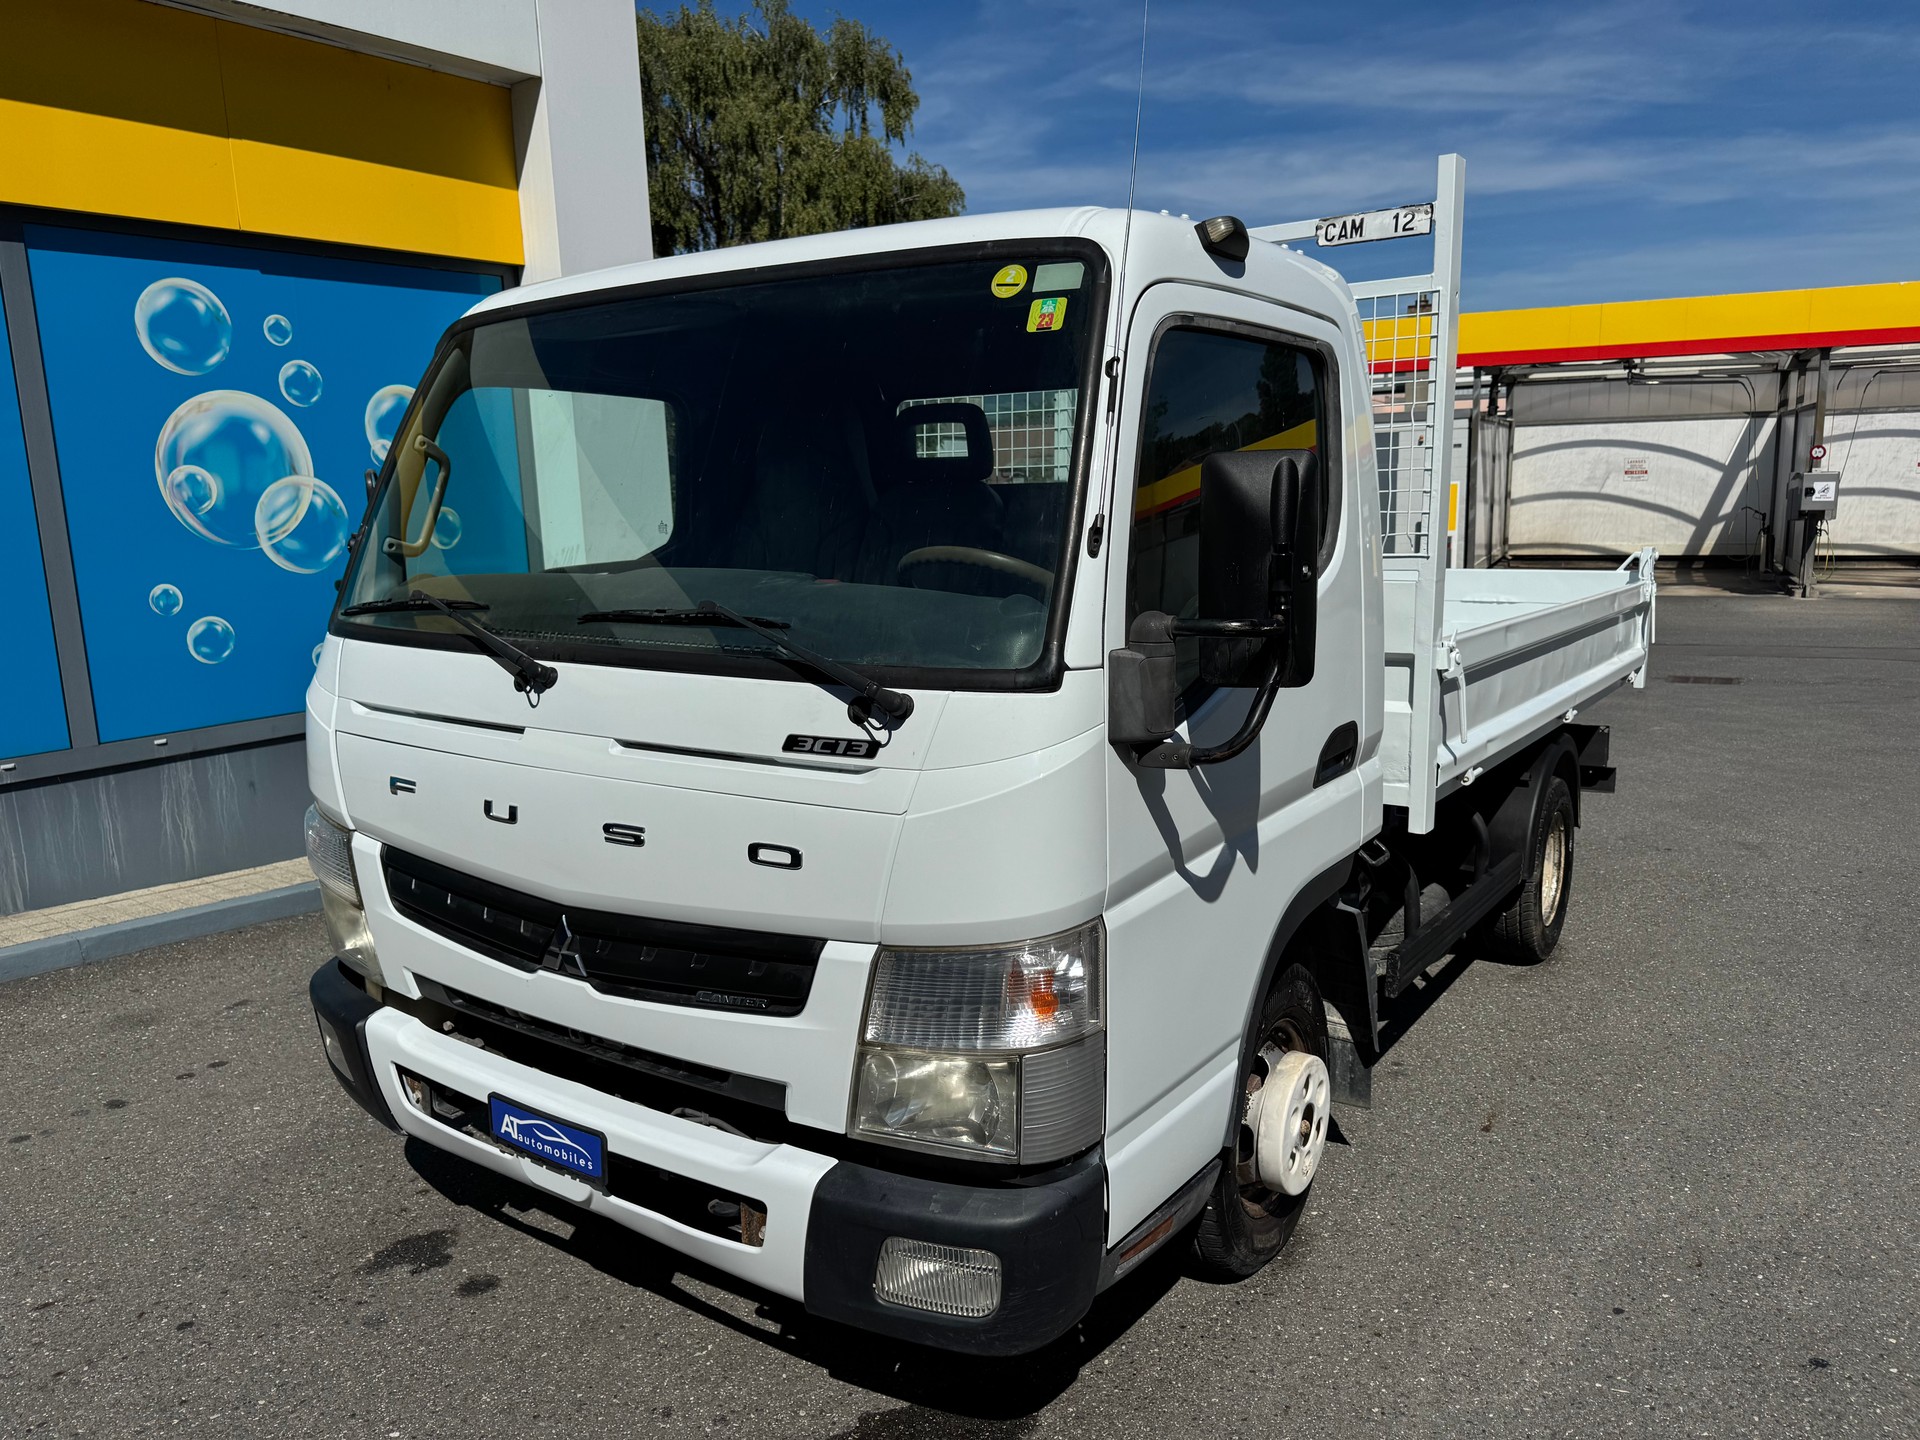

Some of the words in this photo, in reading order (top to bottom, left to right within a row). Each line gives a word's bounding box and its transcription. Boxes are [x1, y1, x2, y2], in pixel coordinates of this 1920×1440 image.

[1324, 217, 1364, 242] CAM
[1392, 211, 1415, 233] 12
[1005, 270, 1016, 283] 2
[1036, 313, 1055, 328] 23
[793, 737, 869, 756] 3C13
[389, 775, 803, 871] FUSO
[696, 991, 768, 1008] CANTER
[501, 1113, 519, 1140] AT
[518, 1133, 593, 1170] automobiles
